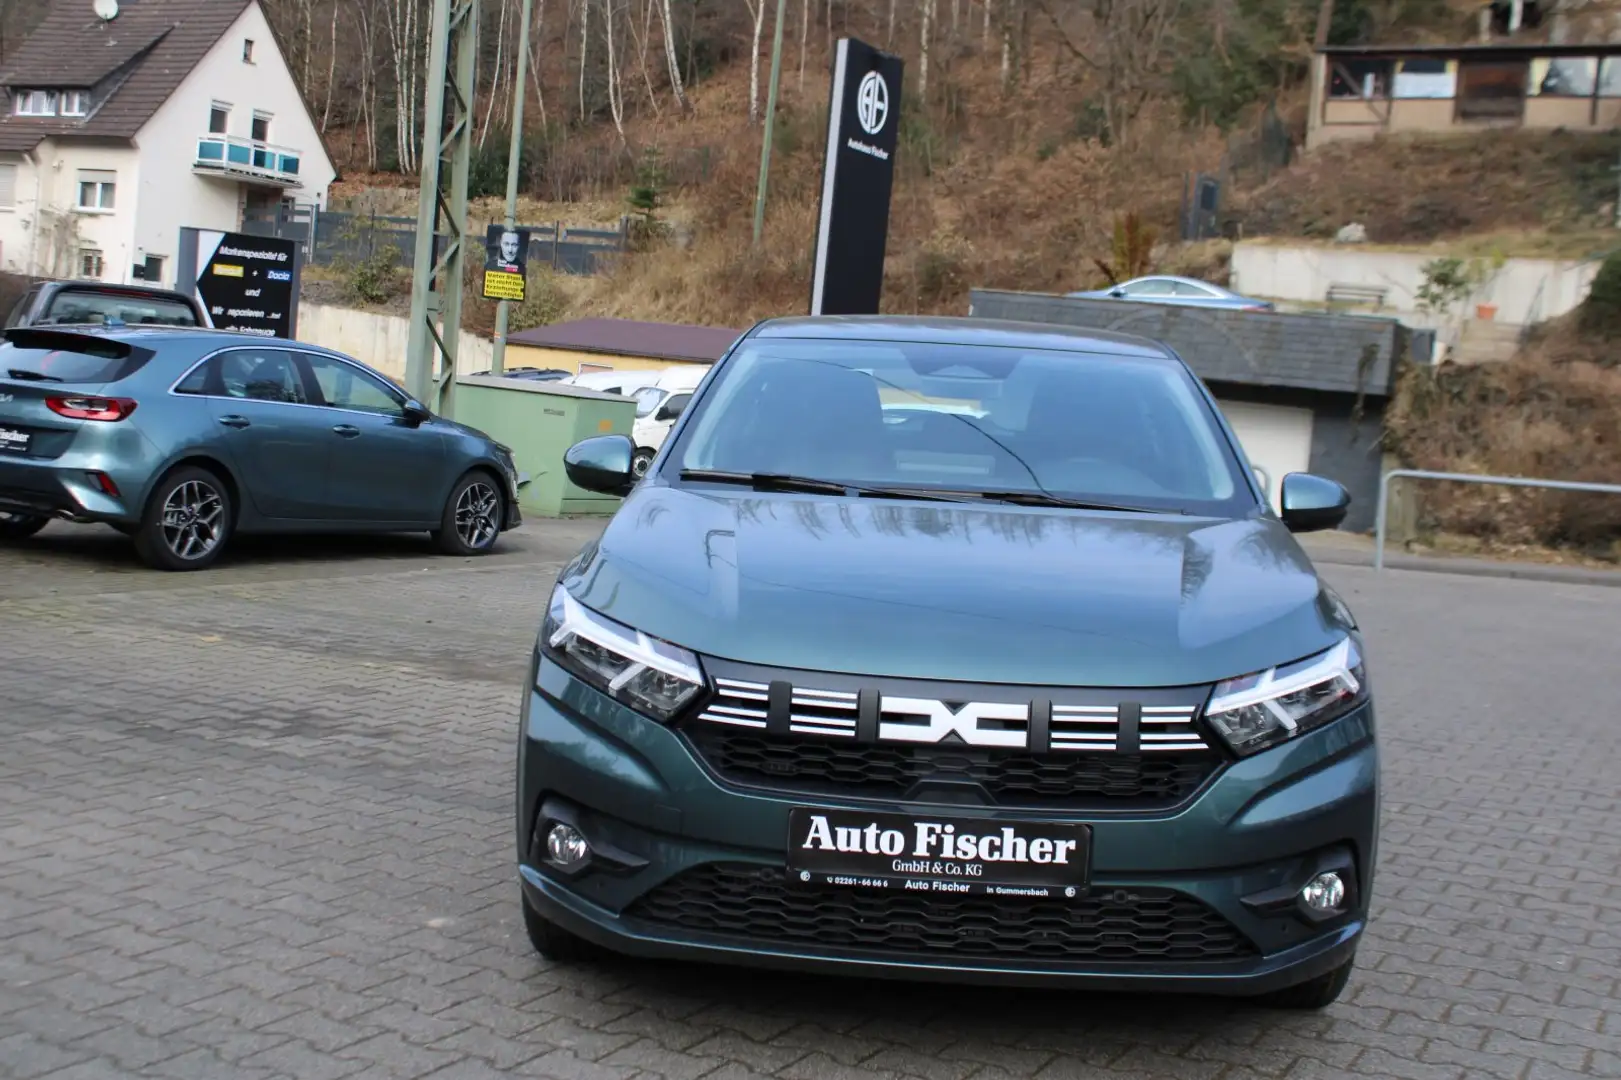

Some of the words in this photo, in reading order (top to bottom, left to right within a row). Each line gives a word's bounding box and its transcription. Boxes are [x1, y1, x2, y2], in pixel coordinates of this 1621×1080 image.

[277, 252, 288, 262] für
[267, 270, 290, 280] Dacia
[244, 288, 261, 297] und
[211, 305, 224, 315] Wir
[227, 308, 265, 318] reparieren
[802, 815, 905, 856] Auto
[912, 822, 1077, 864] Fischer
[892, 859, 930, 873] GmbH
[932, 861, 944, 874] &
[945, 862, 963, 875] Co.
[965, 864, 983, 876] KG
[904, 879, 929, 890] Auto
[932, 881, 971, 893] Fischer
[995, 886, 1049, 897] Gummersbach
